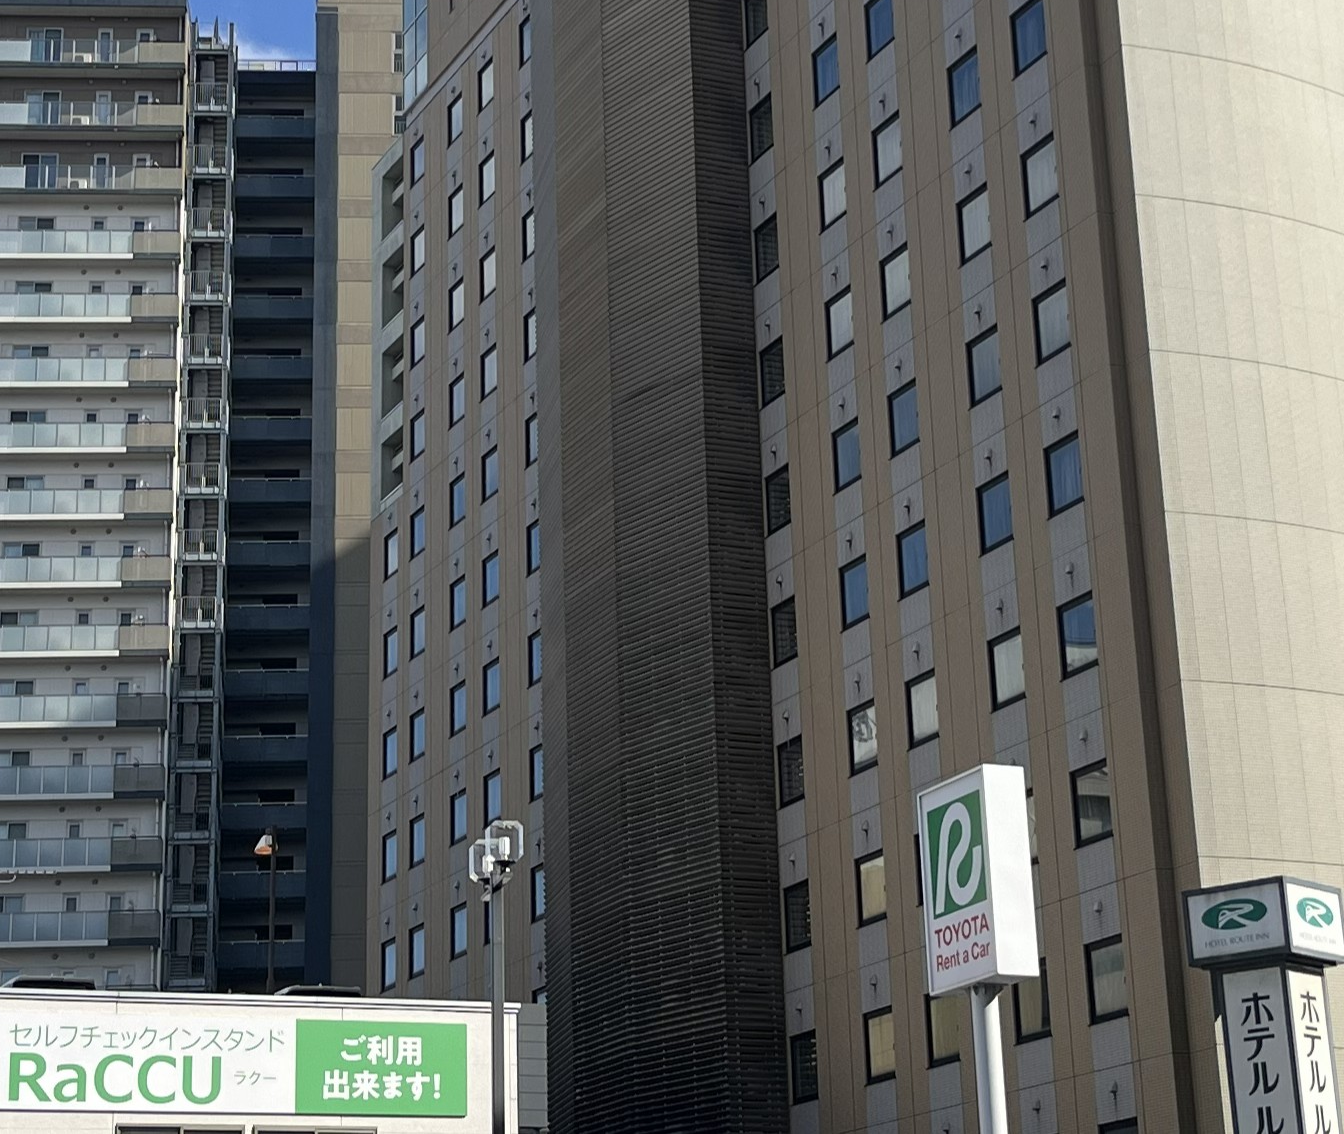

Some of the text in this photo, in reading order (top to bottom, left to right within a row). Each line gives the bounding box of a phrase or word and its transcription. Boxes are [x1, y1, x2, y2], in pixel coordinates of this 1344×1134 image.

[934, 912, 990, 949] TOYOTA
[1204, 939, 1228, 949] HOTEL
[1229, 933, 1254, 945] ROUTE
[936, 941, 991, 973] Rent a Car
[9, 1023, 285, 1053] セルフチェックインスタンド
[340, 1034, 422, 1066] ご利用
[8, 1052, 222, 1105] RaCCU
[233, 1070, 277, 1086] ラクー
[322, 1069, 441, 1101] 出来ます!
